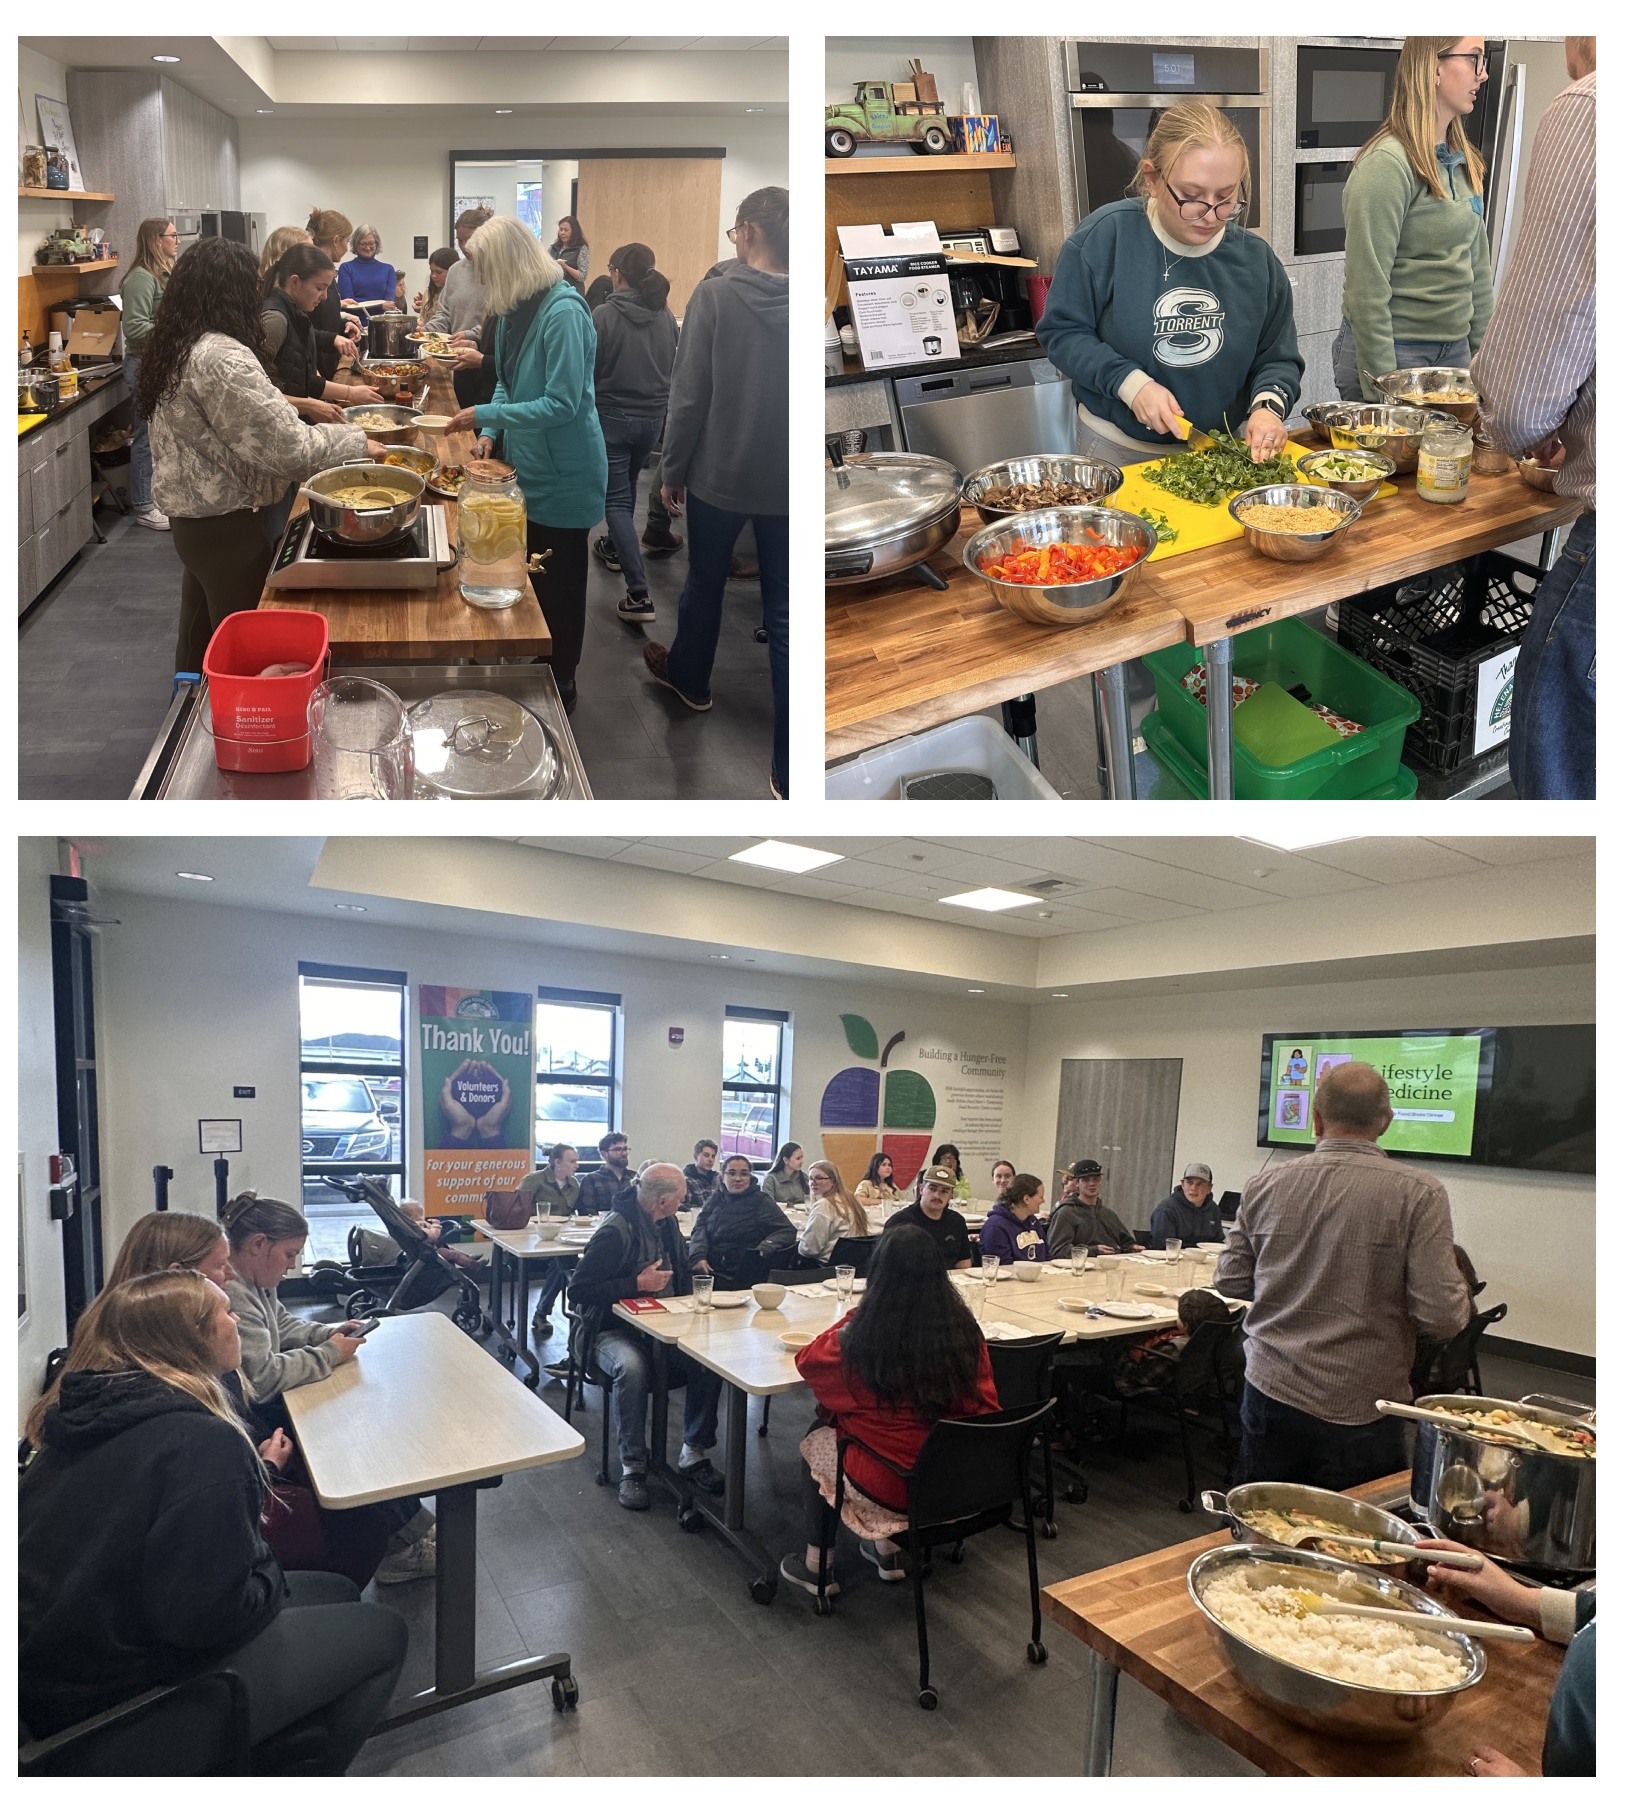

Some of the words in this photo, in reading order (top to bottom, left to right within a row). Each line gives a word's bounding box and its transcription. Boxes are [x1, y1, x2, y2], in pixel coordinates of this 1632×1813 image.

[853, 265, 896, 275] TAYAMA
[1160, 316, 1220, 332] TORRENT
[1496, 656, 1517, 680] Than
[422, 1024, 484, 1052] Thank
[489, 1028, 530, 1055] You!
[919, 1048, 952, 1063] Building
[960, 1051, 1006, 1064] Hunger-Free
[961, 1065, 1006, 1079] Community
[1371, 1064, 1453, 1083] ifestyle
[457, 1081, 499, 1092] Volunteers
[1388, 1084, 1453, 1100] edicine
[460, 1092, 467, 1102] &
[469, 1093, 495, 1103] Donors
[427, 1159, 444, 1170] For
[446, 1160, 473, 1173] your
[475, 1159, 526, 1172] generous
[437, 1176, 481, 1189] support
[484, 1175, 496, 1188] of
[497, 1176, 516, 1186] our
